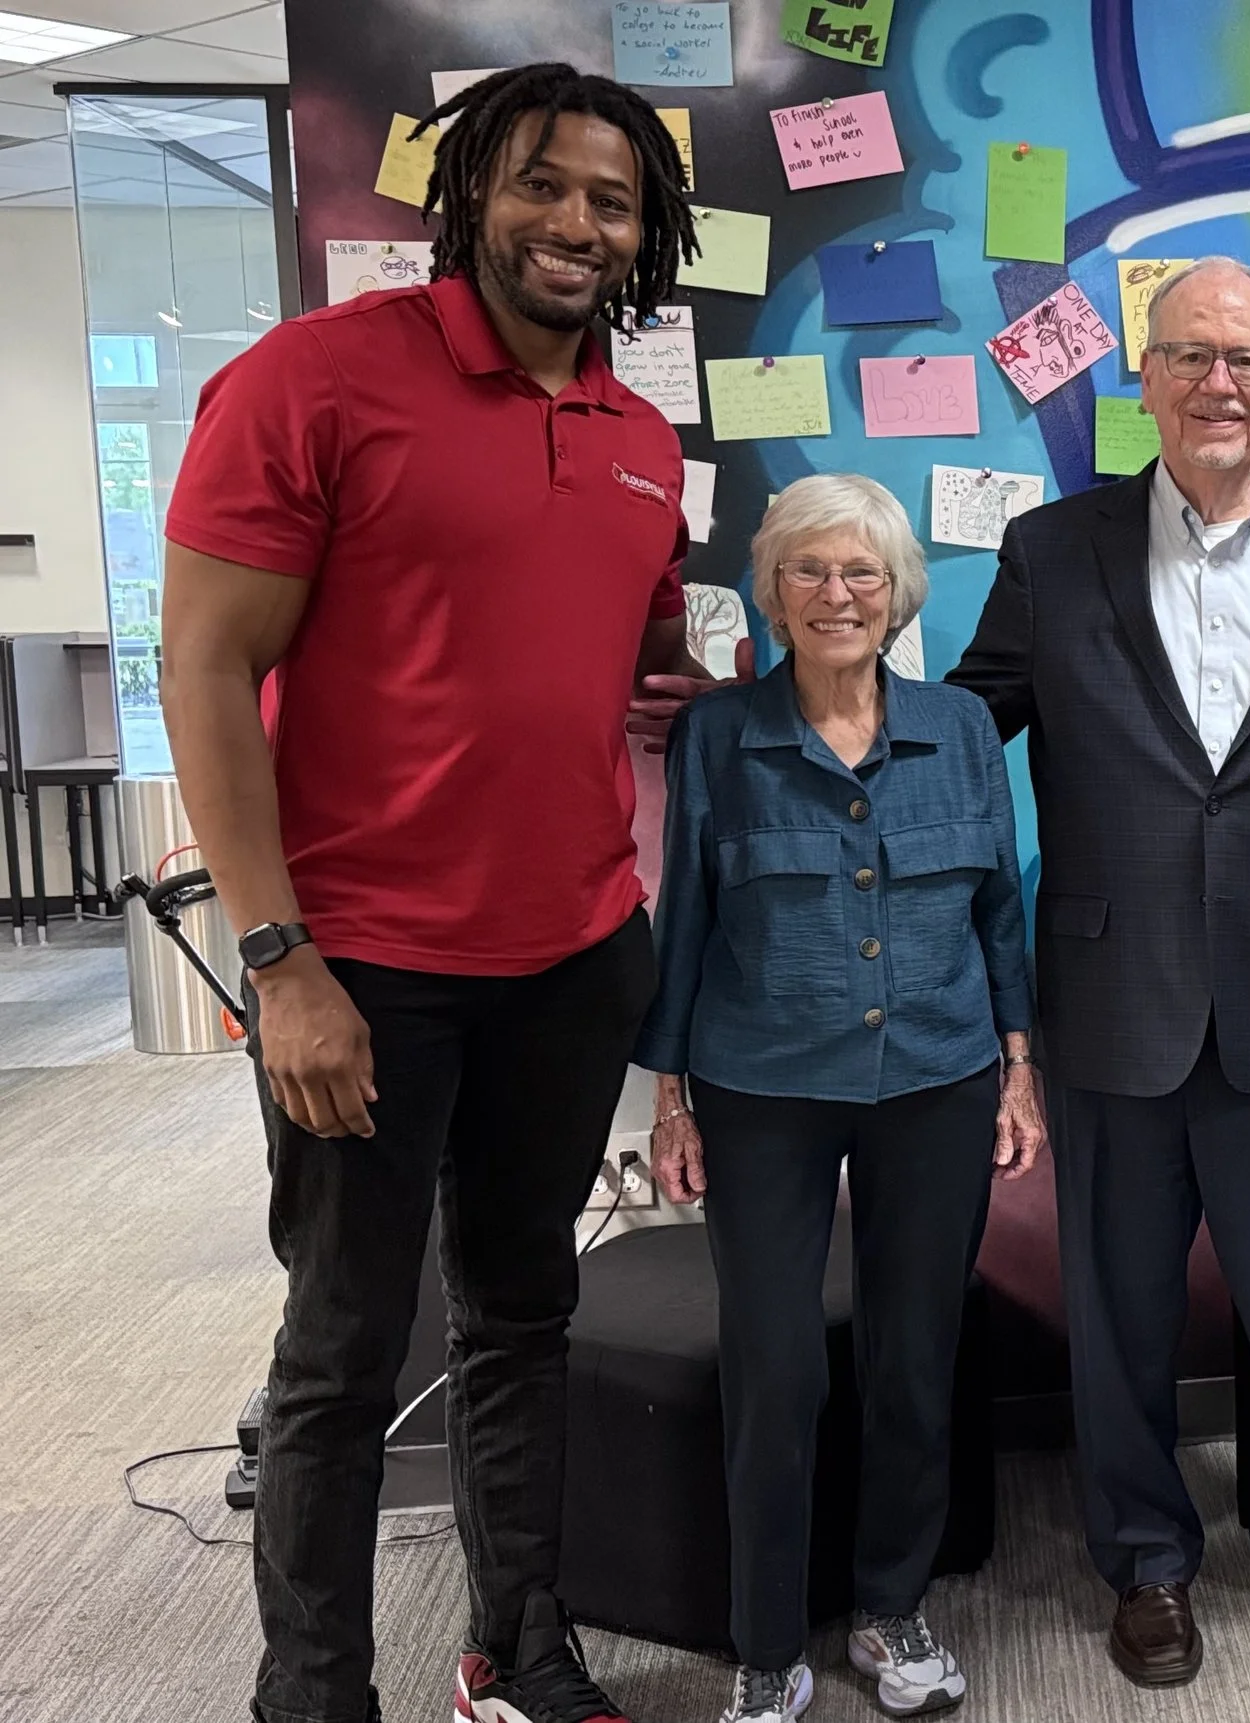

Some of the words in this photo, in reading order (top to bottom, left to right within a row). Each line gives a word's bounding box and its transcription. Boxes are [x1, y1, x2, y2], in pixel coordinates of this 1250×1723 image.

[621, 18, 655, 33] college
[663, 21, 677, 30] to
[805, 6, 881, 62] LIFE
[1064, 284, 1097, 321] ONE
[1090, 321, 1114, 350] DAY
[1073, 322, 1088, 336] AT
[1010, 364, 1041, 401] TIME
